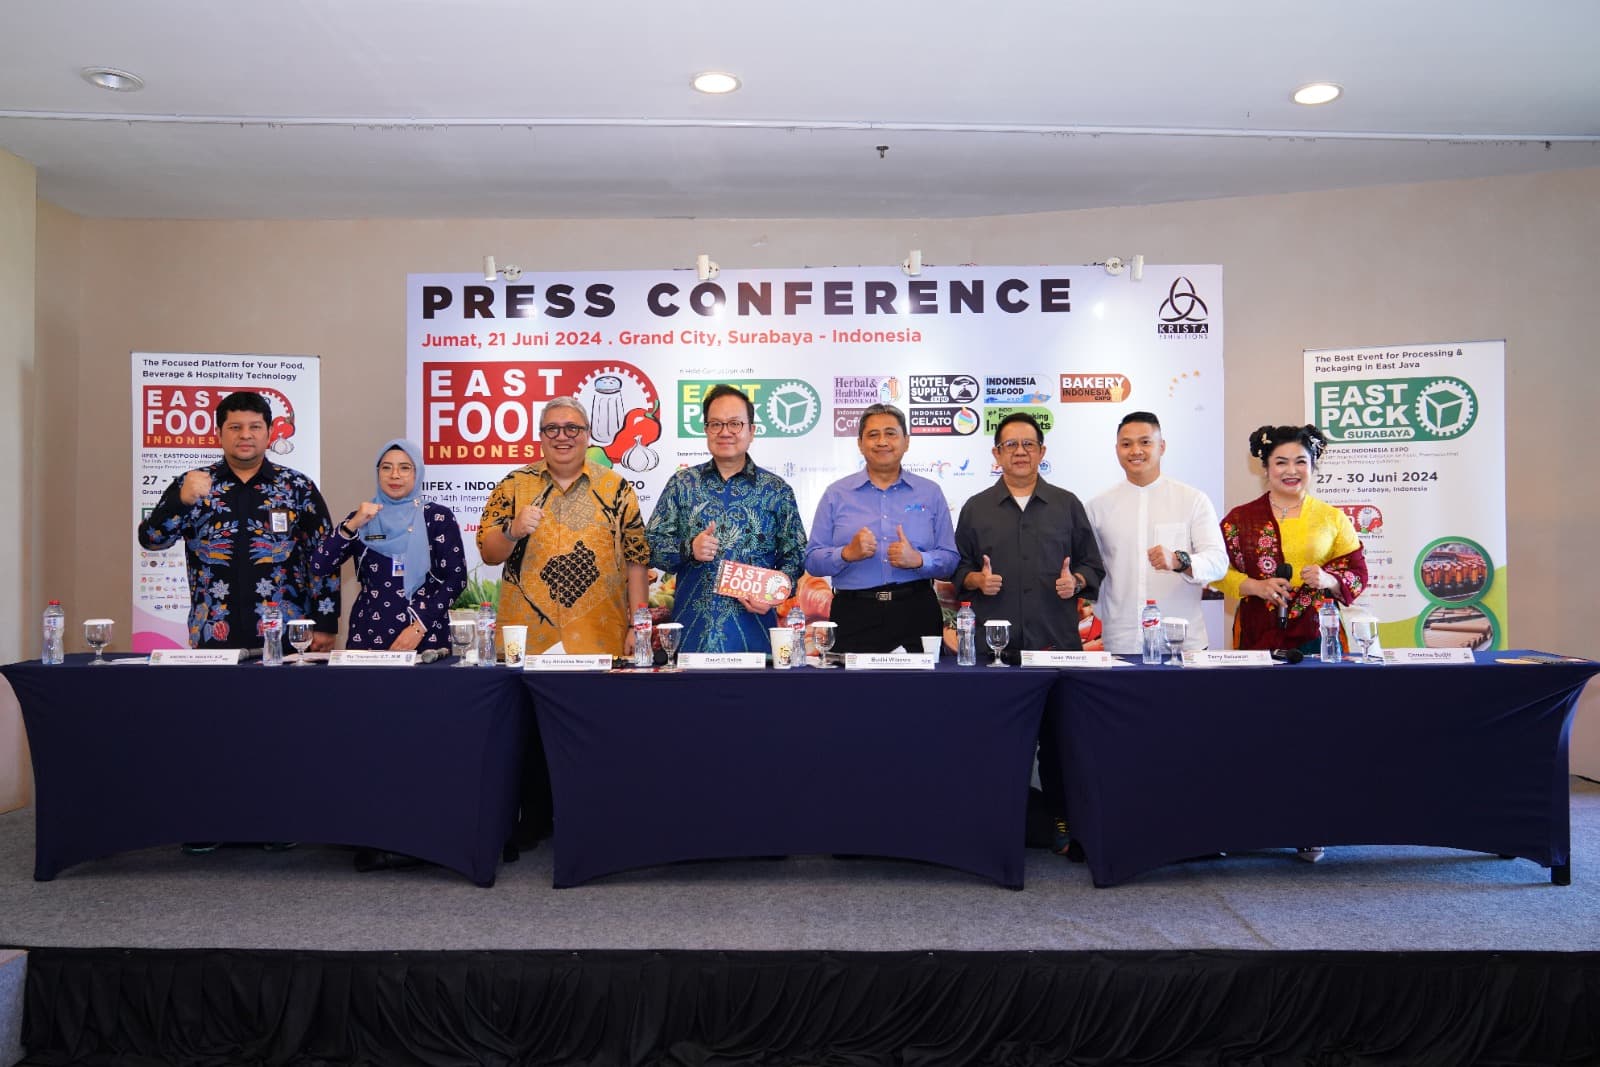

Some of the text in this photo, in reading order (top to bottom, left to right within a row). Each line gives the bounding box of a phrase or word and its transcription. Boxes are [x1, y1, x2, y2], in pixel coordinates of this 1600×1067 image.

[422, 279, 1070, 319] PRESS CONFERENCE
[1159, 325, 1207, 333] KRISTA
[422, 333, 482, 349] Jumat,
[488, 332, 506, 346] 21
[512, 331, 549, 346] Juni
[555, 331, 602, 345] 2024
[619, 331, 673, 345] Grand
[681, 330, 721, 347] City,
[728, 329, 813, 346] Surabaya
[832, 328, 922, 343] Indonesia
[1334, 354, 1354, 362] Best
[1357, 353, 1383, 361] Event
[1402, 349, 1453, 360] Processing
[1456, 348, 1463, 356] &
[143, 359, 159, 367] The
[162, 359, 199, 367] Focused
[201, 360, 240, 368] Platform
[256, 361, 278, 369] Your
[280, 362, 305, 370] Food,
[1315, 365, 1362, 373] Packaging
[1365, 362, 1373, 370] in
[142, 370, 184, 379] Beverage
[195, 371, 244, 380] Hospitality
[246, 372, 297, 381] Technology
[431, 368, 563, 397] EAST
[910, 377, 949, 387] HOTEL
[986, 377, 1036, 386] INDONESIA
[1062, 377, 1125, 389] BAKERY
[683, 384, 761, 403] ET
[911, 387, 949, 396] SUPPLY
[1062, 388, 1111, 396] INDONESIA
[1321, 383, 1409, 407] EAST
[1032, 412, 1049, 421] king
[1321, 404, 1410, 427] PACK
[147, 409, 217, 435] FOO
[911, 417, 952, 426] GELATO
[1347, 429, 1411, 439] SURABAYA
[429, 444, 545, 459] INDONESI
[142, 475, 158, 485] 27
[1316, 474, 1333, 484] 27
[1347, 473, 1365, 483] 30
[1369, 472, 1398, 483] Juni
[1402, 471, 1438, 482] 2024
[422, 481, 453, 491] IIFEX
[464, 481, 497, 491] INDO
[723, 564, 766, 582] EAST
[720, 574, 763, 594] FOOD
